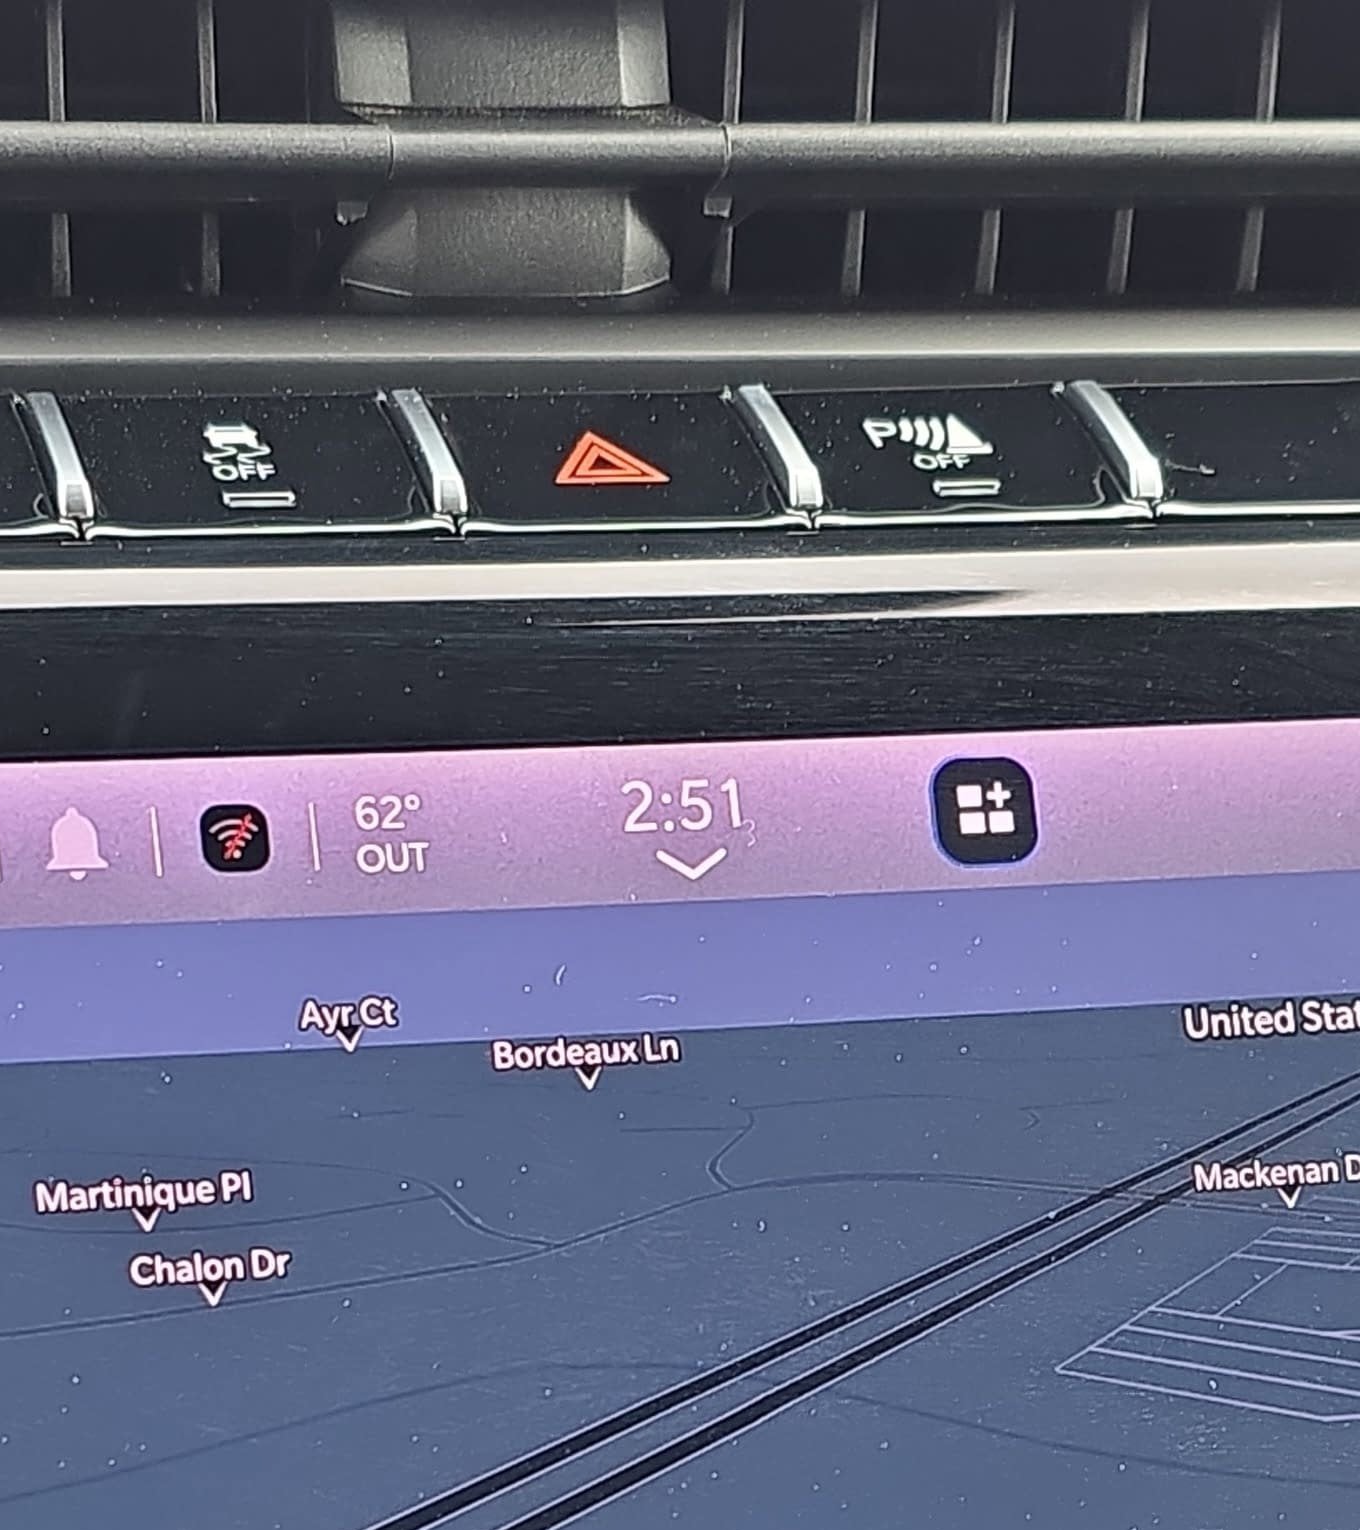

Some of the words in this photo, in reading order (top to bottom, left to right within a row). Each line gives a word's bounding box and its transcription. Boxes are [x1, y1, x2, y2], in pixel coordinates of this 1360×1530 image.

[212, 462, 276, 481] OFF
[912, 452, 971, 471] OFF
[355, 794, 421, 831] 62°
[621, 778, 745, 833] 2:51
[356, 842, 429, 874] OUT
[299, 1000, 358, 1034] Ayr
[359, 995, 399, 1028] Ct
[1182, 999, 1295, 1040] United
[492, 1037, 639, 1072] Bordeaux
[643, 1033, 681, 1063] Ln
[36, 1174, 216, 1214] Martinique
[221, 1171, 252, 1203] Pl
[1193, 1159, 1340, 1193] Mackenan
[129, 1255, 246, 1287] Chalon
[251, 1249, 290, 1282] Dr
